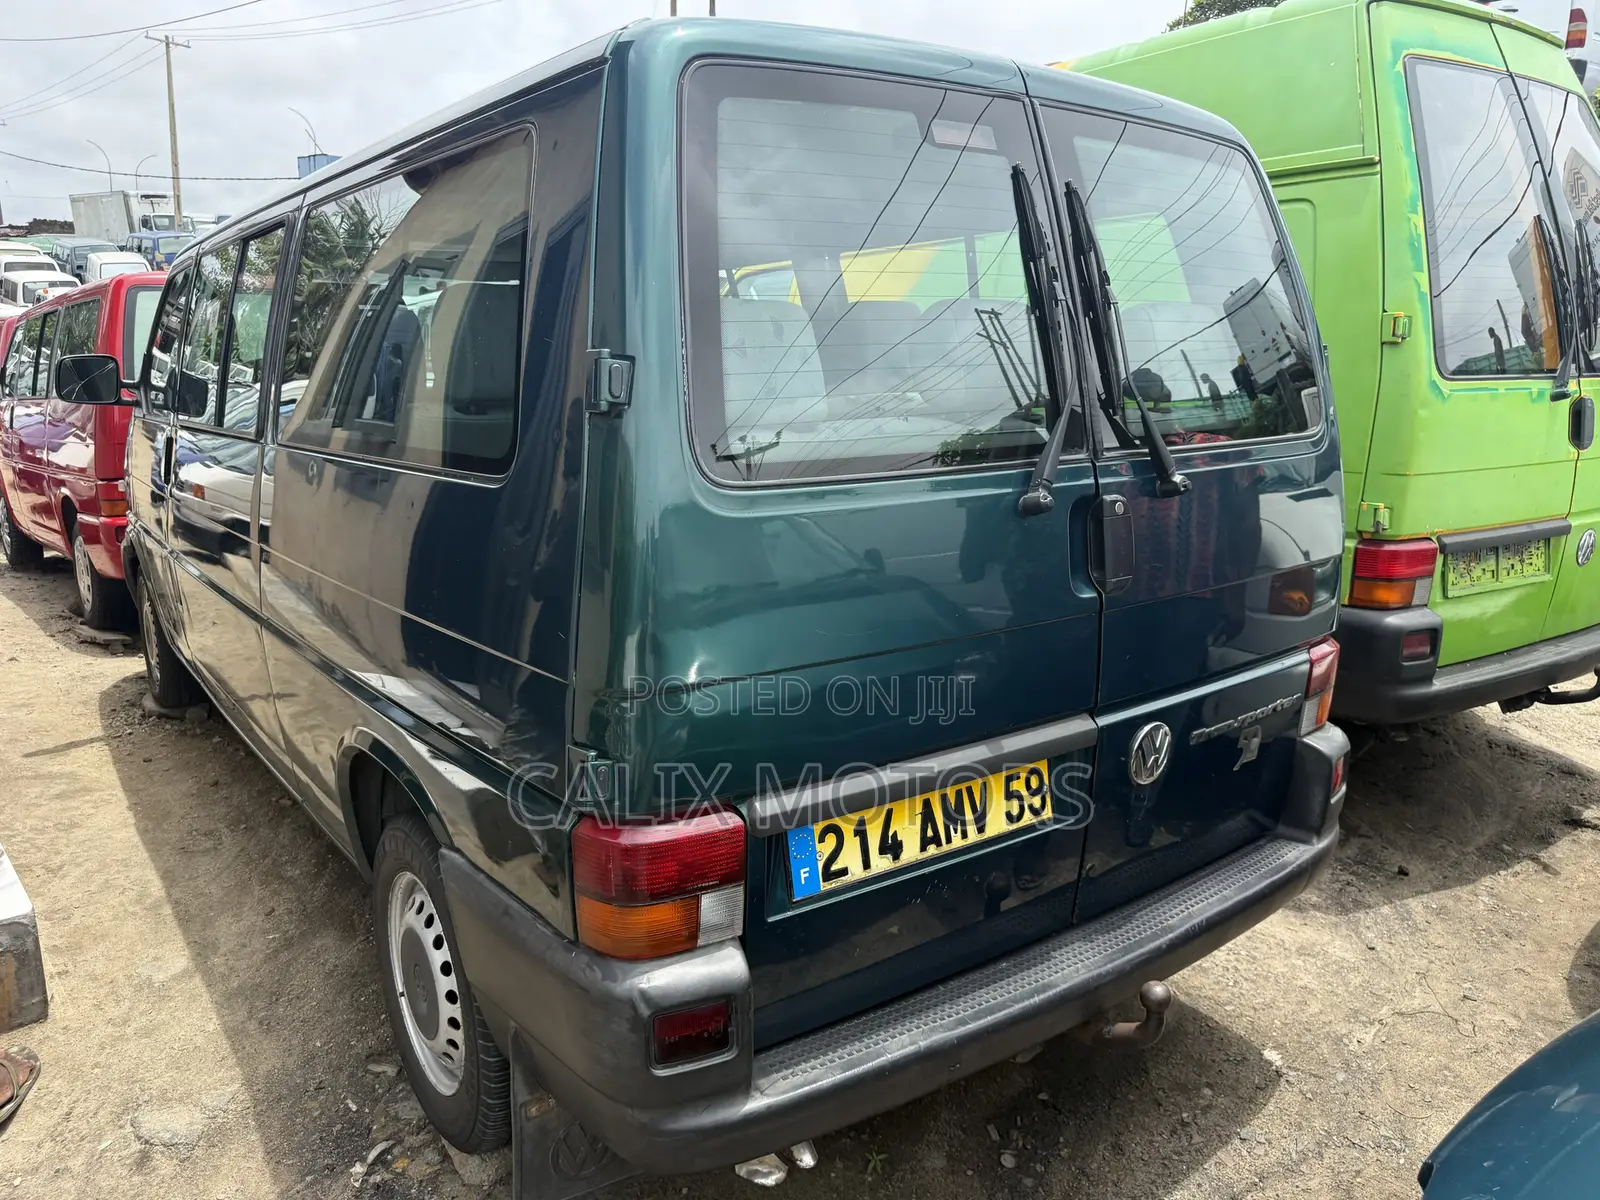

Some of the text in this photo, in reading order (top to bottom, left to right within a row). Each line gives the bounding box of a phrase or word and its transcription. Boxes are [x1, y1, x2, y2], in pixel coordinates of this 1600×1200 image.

[1130, 721, 1171, 785] VW
[818, 767, 1047, 883] 214 AMV 59
[800, 867, 810, 885] F
